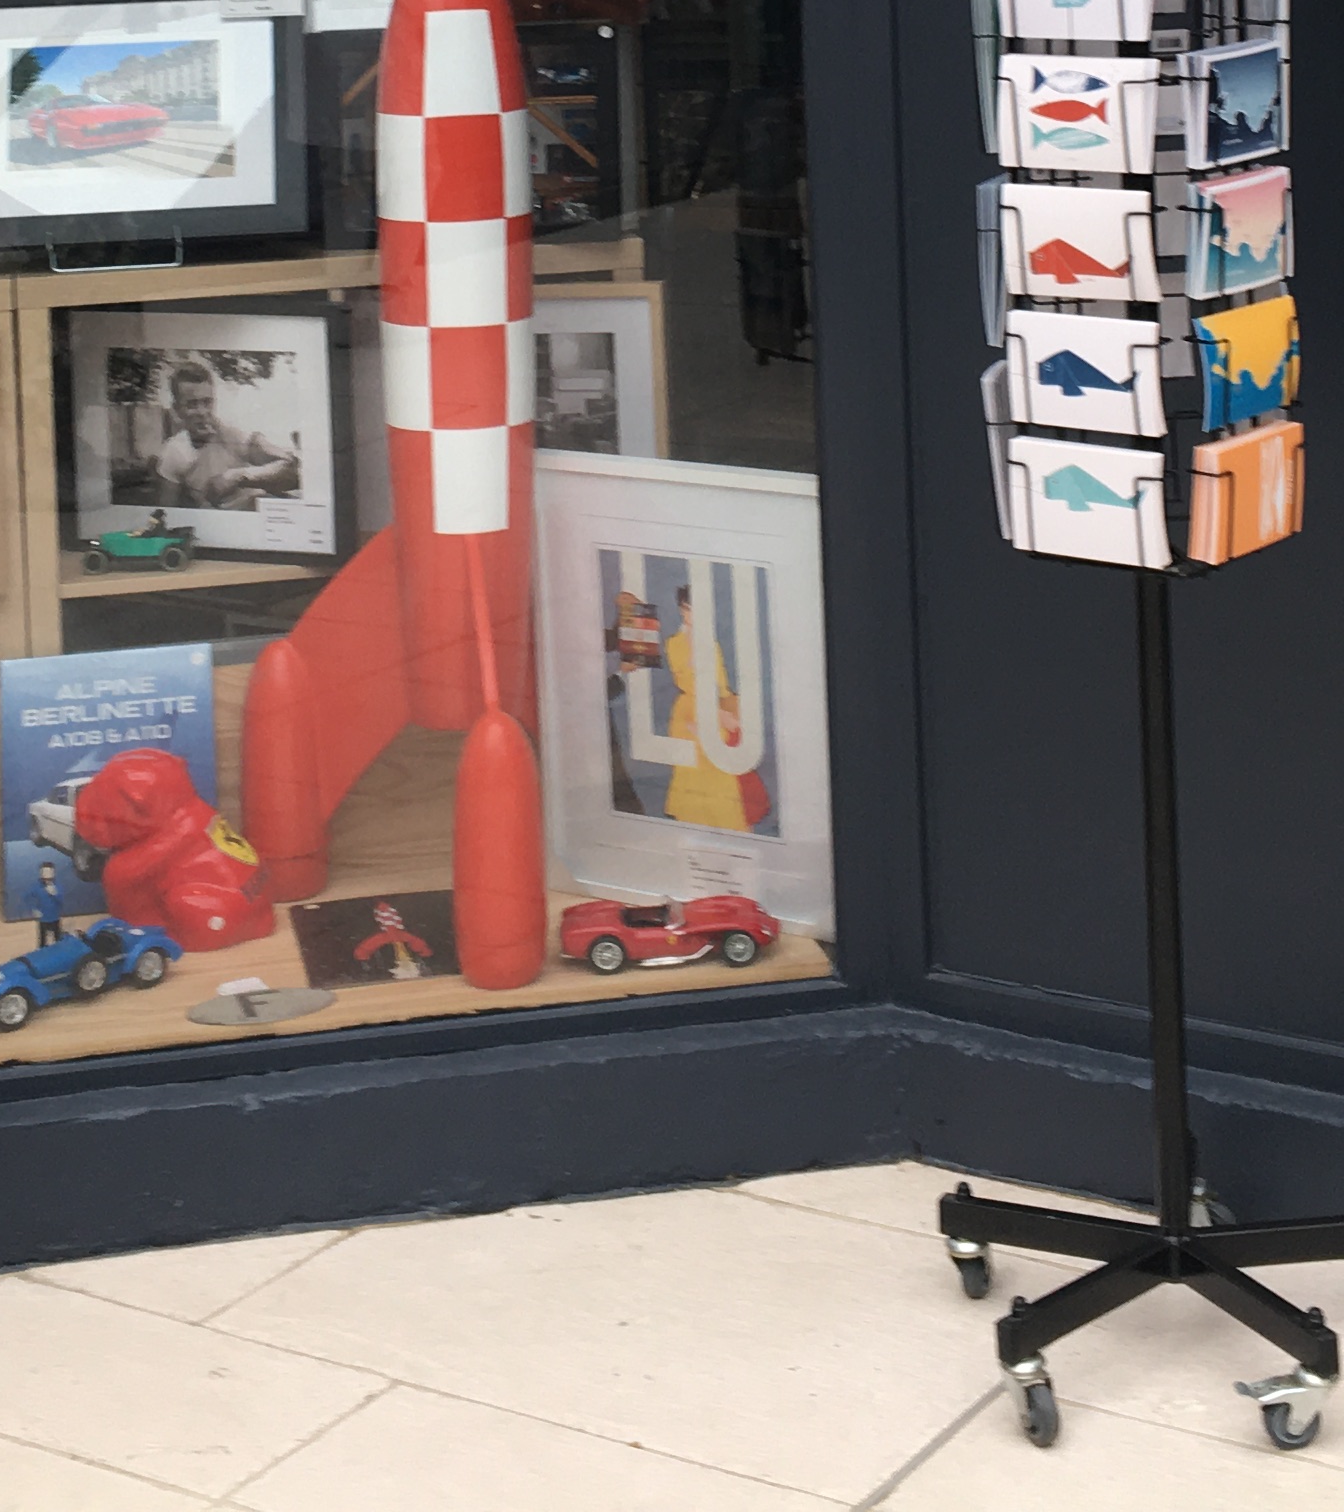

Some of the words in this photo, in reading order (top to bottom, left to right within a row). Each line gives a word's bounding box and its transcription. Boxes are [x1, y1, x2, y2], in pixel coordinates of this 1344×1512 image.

[619, 550, 764, 776] LU
[56, 676, 158, 701] ALPINE
[20, 695, 199, 728] BERLINETTE
